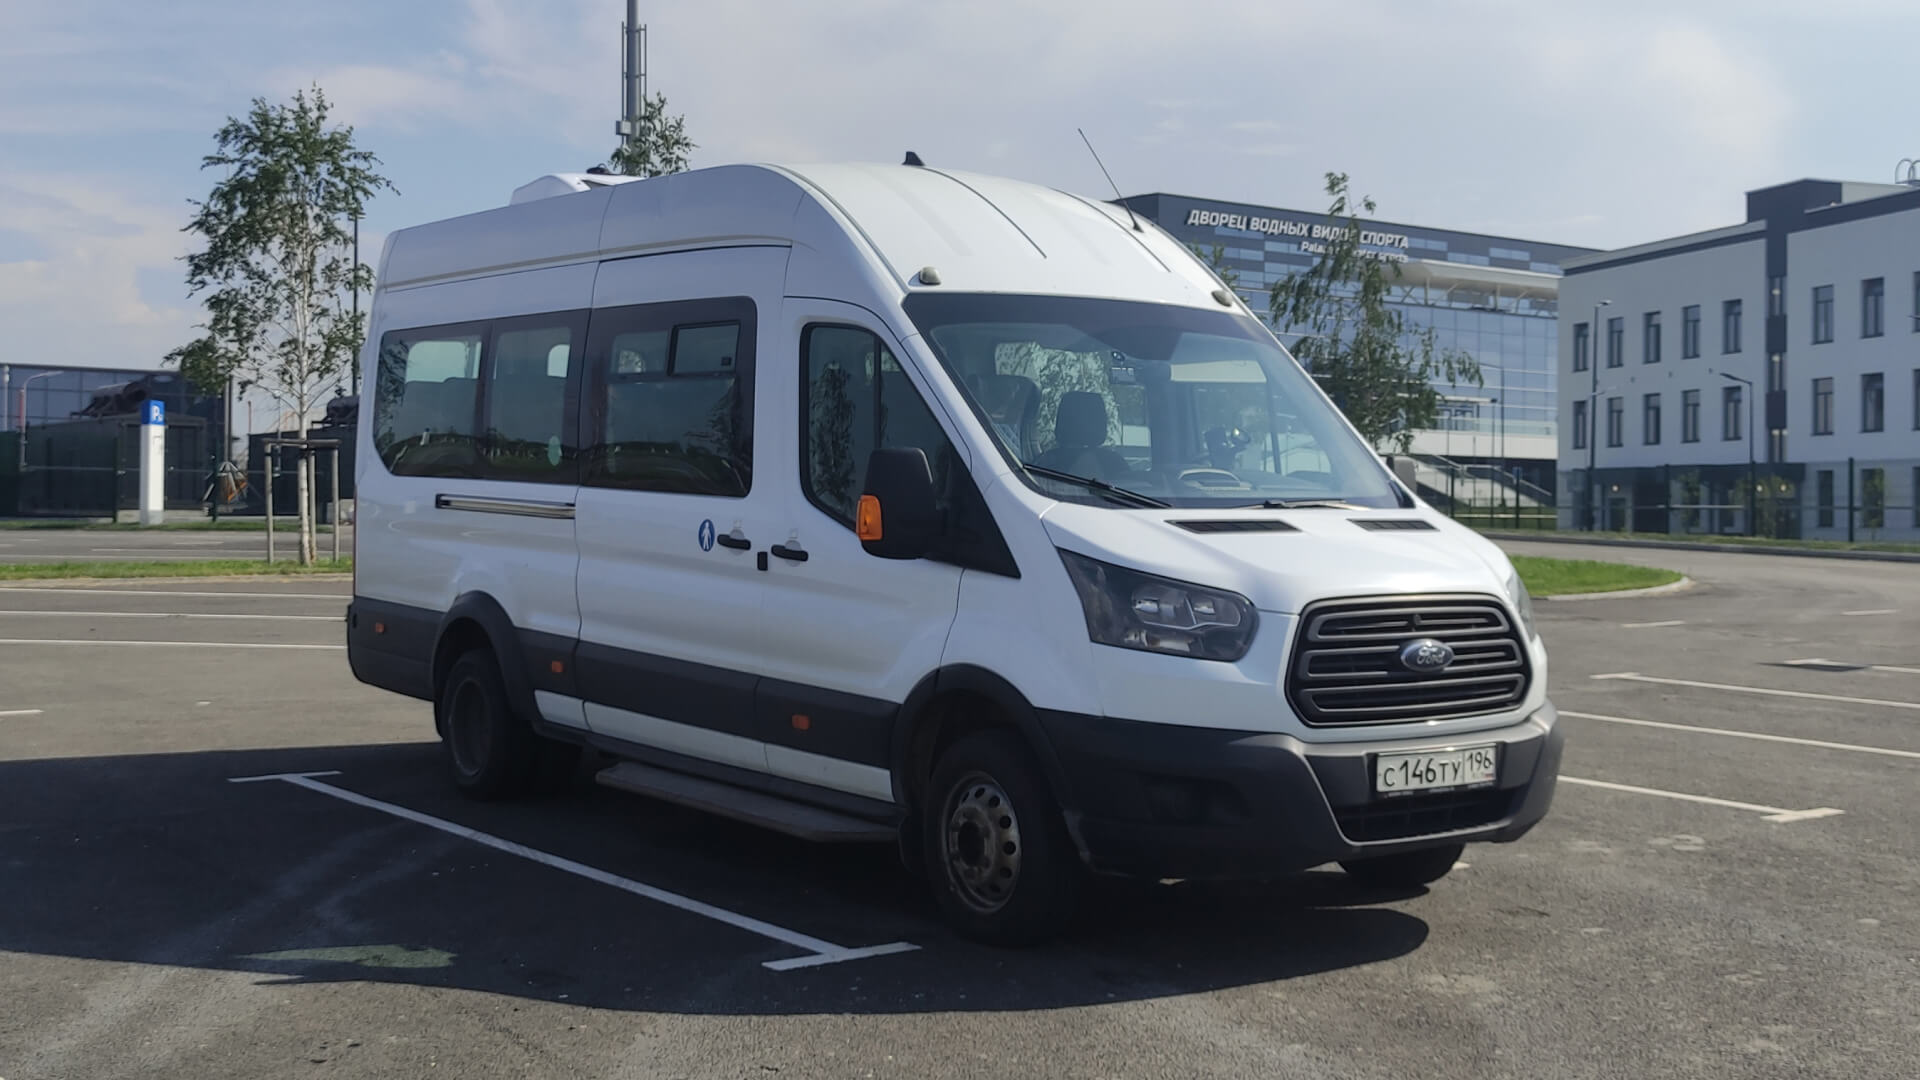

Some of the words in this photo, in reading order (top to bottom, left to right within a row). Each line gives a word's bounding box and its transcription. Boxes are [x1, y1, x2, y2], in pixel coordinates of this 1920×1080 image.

[1187, 209, 1247, 232] ДВОРЕЦ
[1249, 216, 1309, 238] ВОДНЫХ
[1359, 230, 1409, 249] СПОРТА
[1466, 751, 1494, 772] 196
